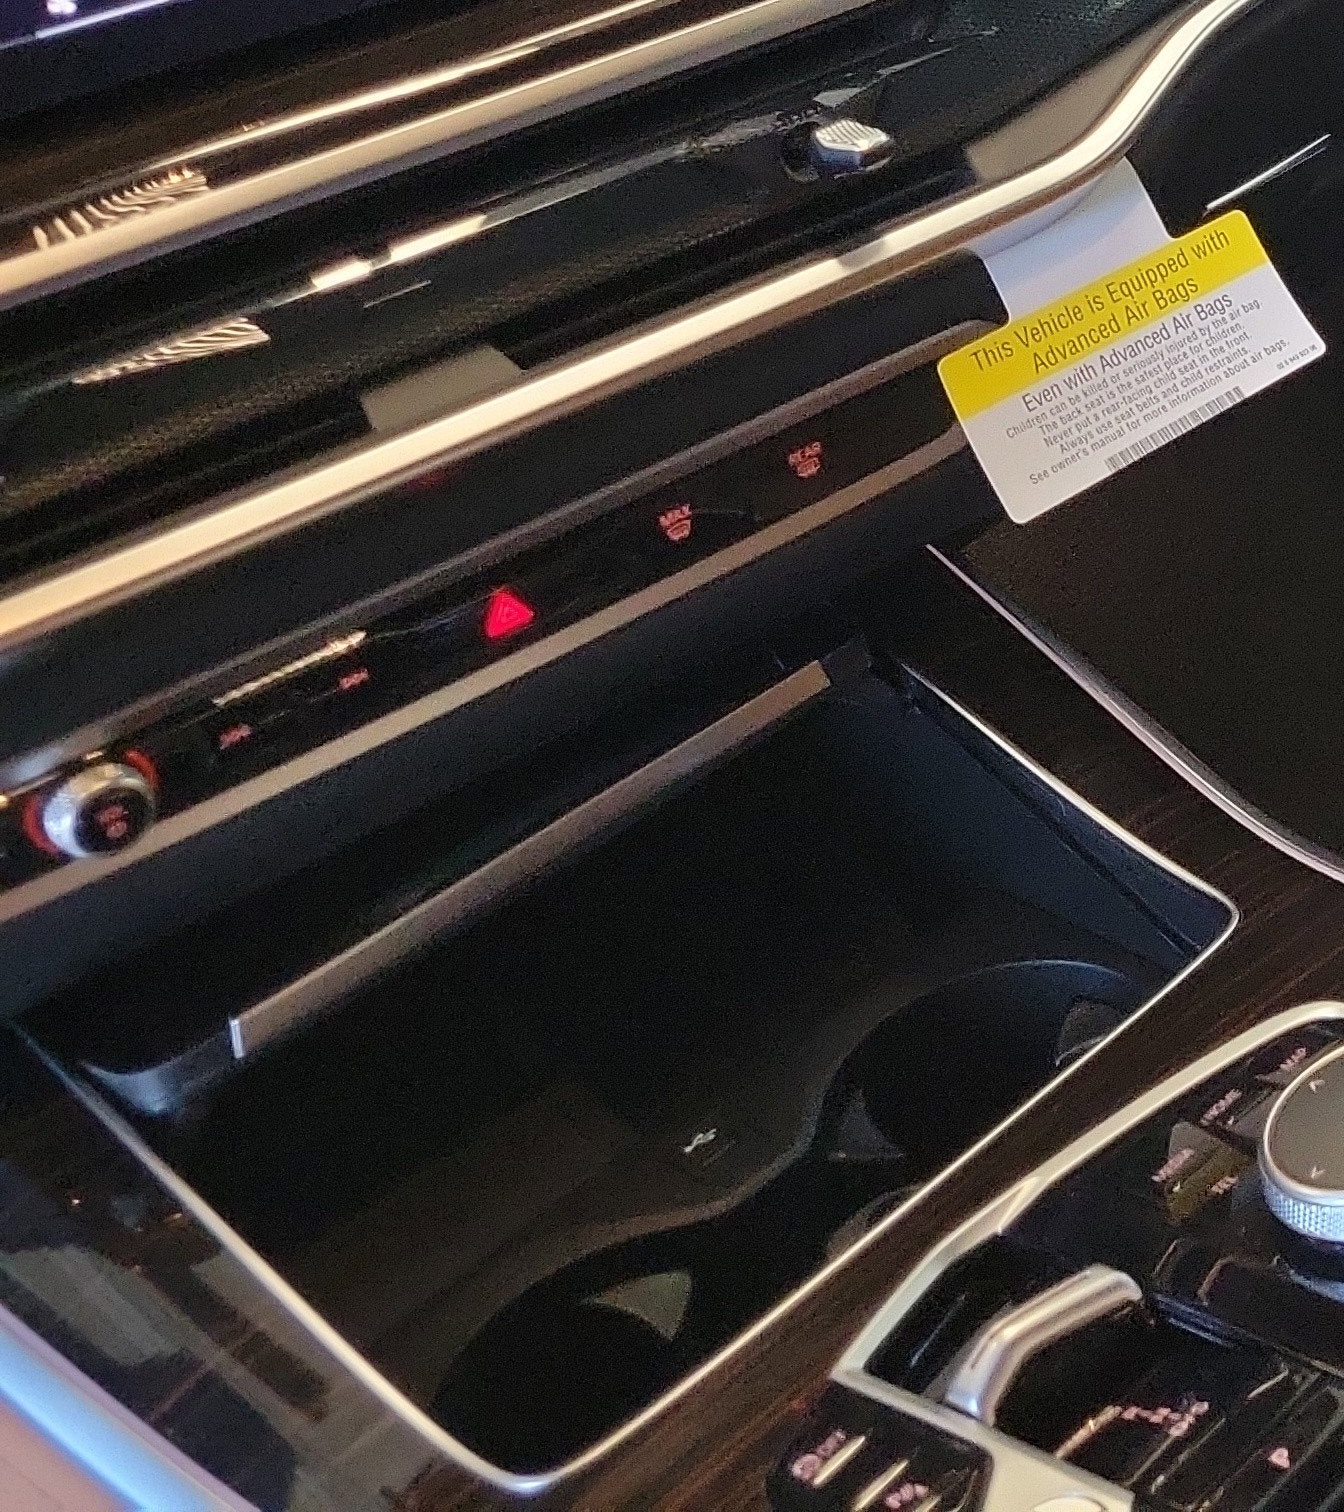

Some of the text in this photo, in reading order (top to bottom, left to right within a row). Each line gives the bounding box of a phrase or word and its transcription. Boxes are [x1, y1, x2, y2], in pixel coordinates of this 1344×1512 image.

[969, 229, 1229, 370] This Vehicle is Equipped with
[1021, 294, 1232, 412] Even with Advanced Air Bags
[1033, 277, 1198, 373] Advanced Air Bags
[1006, 299, 1261, 438] Children can be killed or seriously injured by the air bag.
[1029, 469, 1049, 484] See
[1050, 447, 1089, 473] owner's
[1090, 425, 1125, 451] manual
[1125, 418, 1140, 431] for
[1143, 404, 1167, 422] more
[1223, 358, 1250, 378] about
[1250, 351, 1262, 363] air
[1262, 339, 1289, 355] bags.
[1038, 322, 1244, 435] The back seat is the safest place for children.
[1043, 427, 1072, 447] Never
[1074, 416, 1092, 433] put
[1093, 413, 1099, 421] a
[1153, 370, 1176, 388] child
[1178, 359, 1198, 375] seat
[1197, 354, 1209, 364] in
[1209, 345, 1225, 357] the
[1225, 331, 1251, 349] front.
[1059, 430, 1094, 453] Always
[1095, 420, 1113, 434] use
[1114, 407, 1135, 423] seat
[1135, 395, 1160, 412] belts
[1161, 383, 1179, 398] and
[1180, 369, 1203, 387] child
